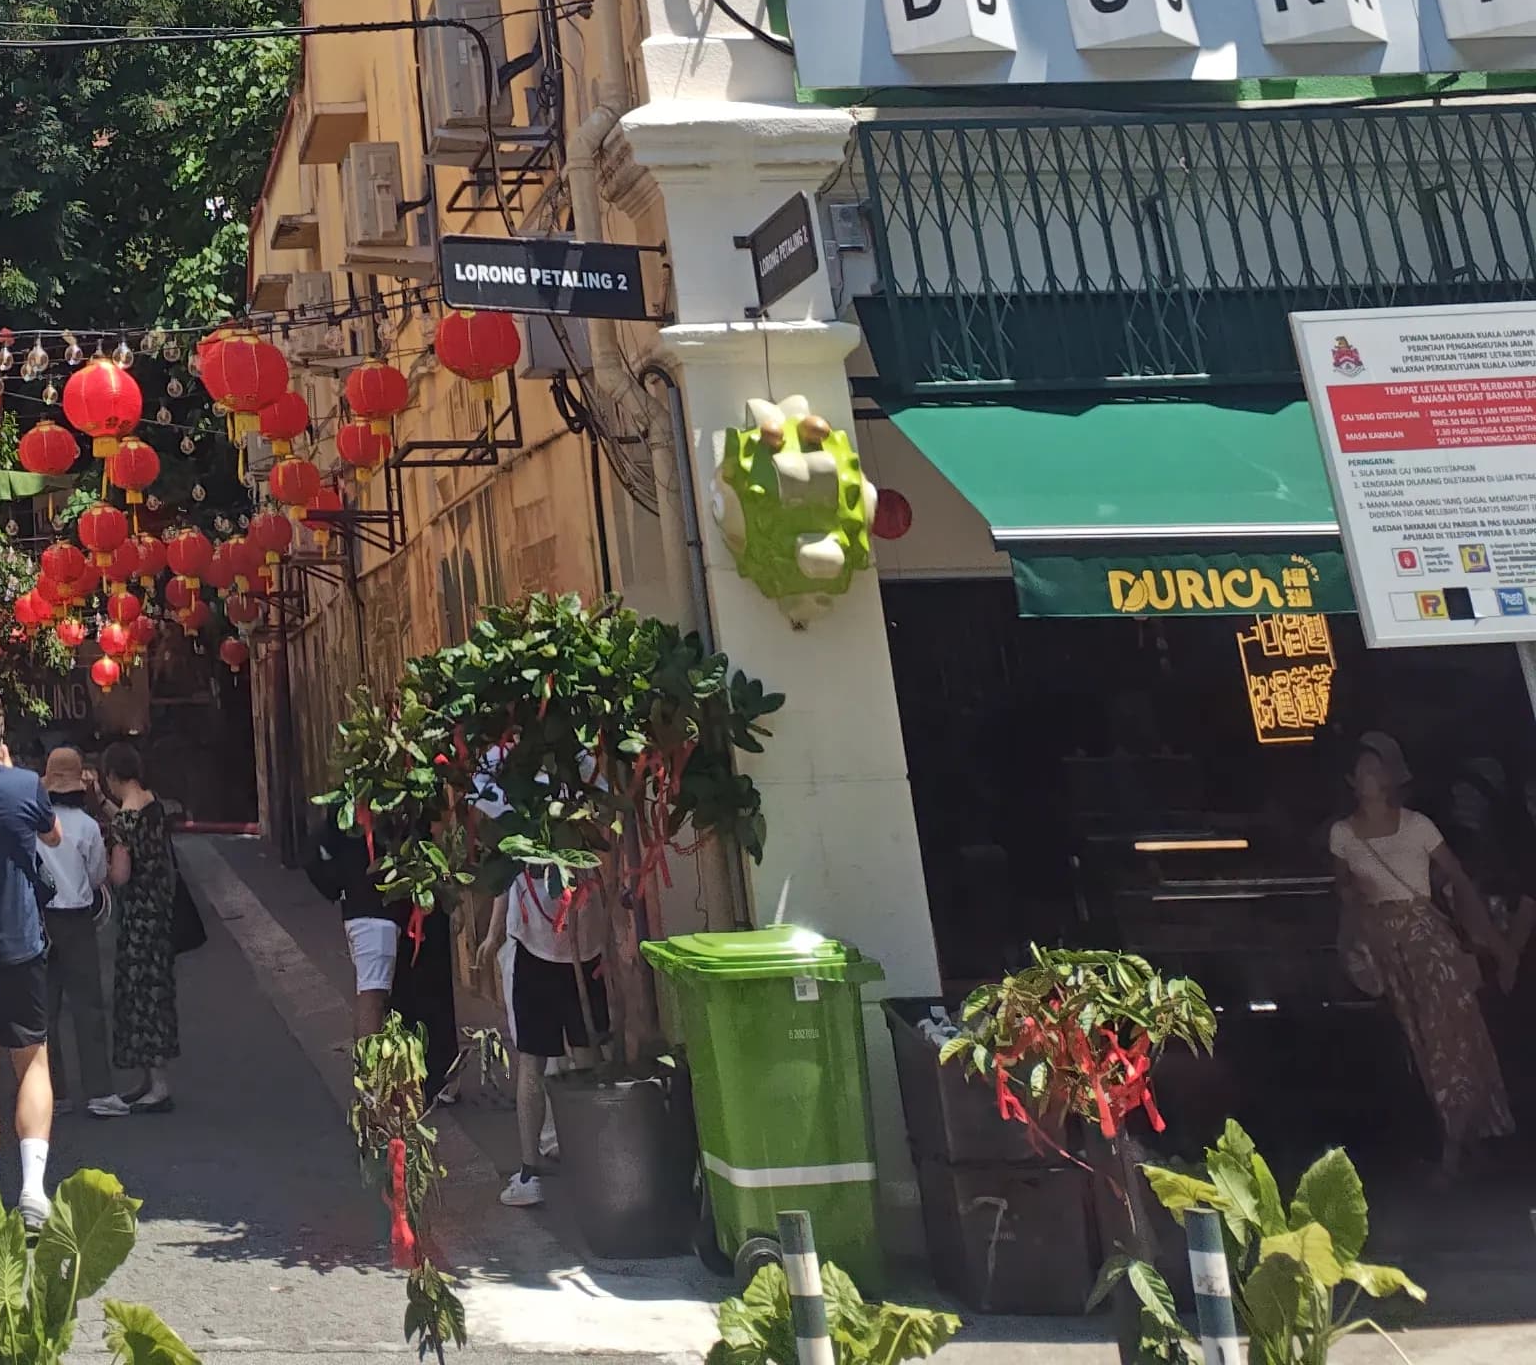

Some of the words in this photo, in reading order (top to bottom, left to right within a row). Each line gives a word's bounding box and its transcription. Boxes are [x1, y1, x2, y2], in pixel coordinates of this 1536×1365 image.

[759, 247, 780, 277] LORONG
[779, 228, 804, 263] PETALING
[802, 224, 809, 244] 2
[455, 263, 526, 284] LORONG
[531, 267, 613, 289] PETALING
[617, 274, 628, 290] 2
[1384, 386, 1419, 395] TEMPAT
[1457, 393, 1484, 402] PUSAT
